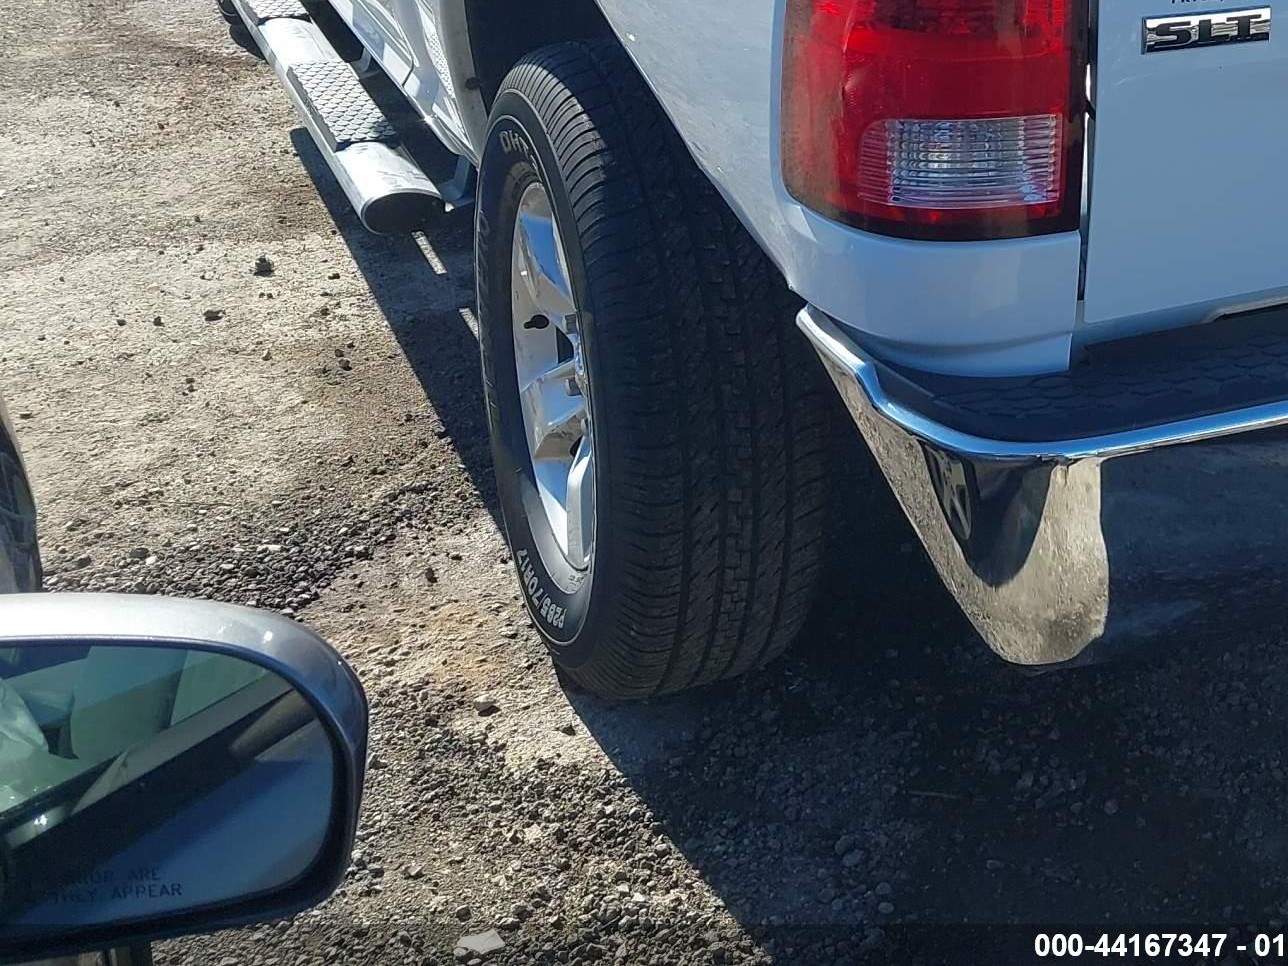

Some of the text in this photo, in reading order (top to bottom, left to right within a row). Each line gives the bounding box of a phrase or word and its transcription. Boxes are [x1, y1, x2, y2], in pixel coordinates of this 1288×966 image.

[1144, 11, 1268, 51] SLT
[128, 867, 160, 882] ARE
[111, 883, 182, 900] APPEAR
